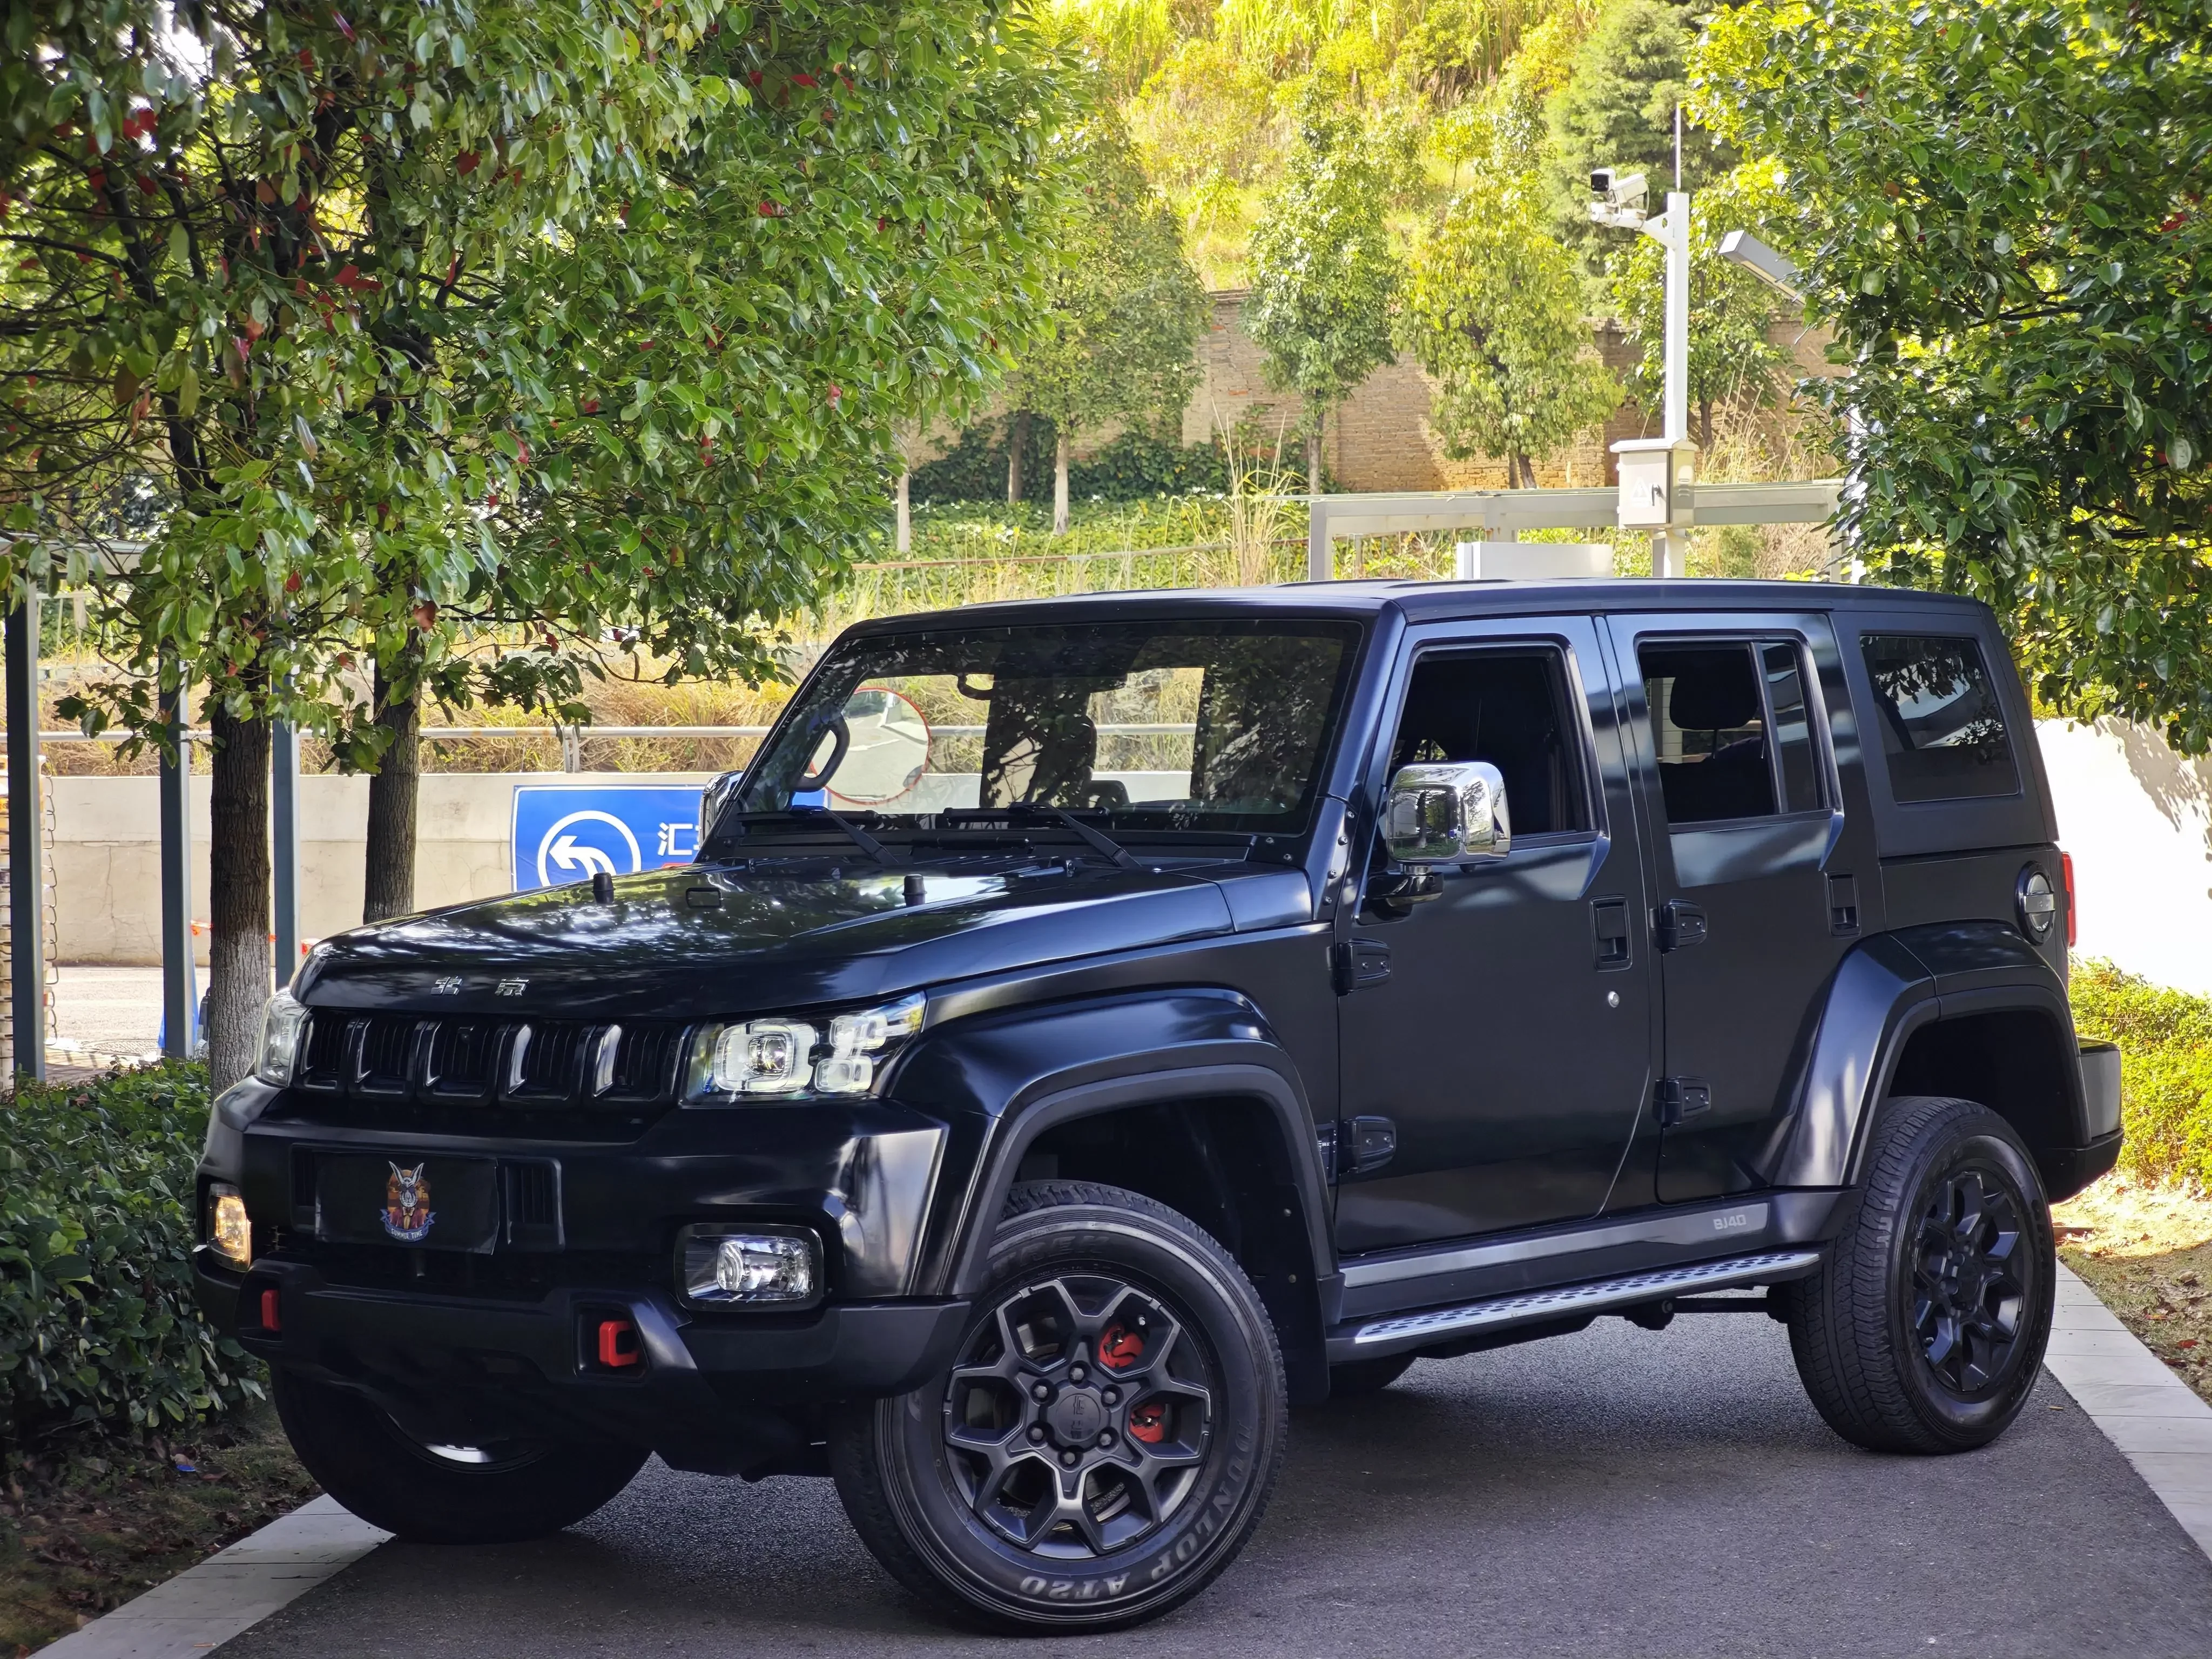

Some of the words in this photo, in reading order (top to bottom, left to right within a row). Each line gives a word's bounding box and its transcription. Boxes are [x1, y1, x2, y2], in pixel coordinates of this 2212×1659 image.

[657, 822, 699, 857] 汇
[430, 976, 530, 996] 北京
[391, 1229, 409, 1239] SUMMER
[412, 1230, 423, 1239] TIME
[1713, 1215, 1746, 1230] BJ40
[1151, 1418, 1253, 1581] DUNLOP
[1019, 1572, 1130, 1600] AT20
